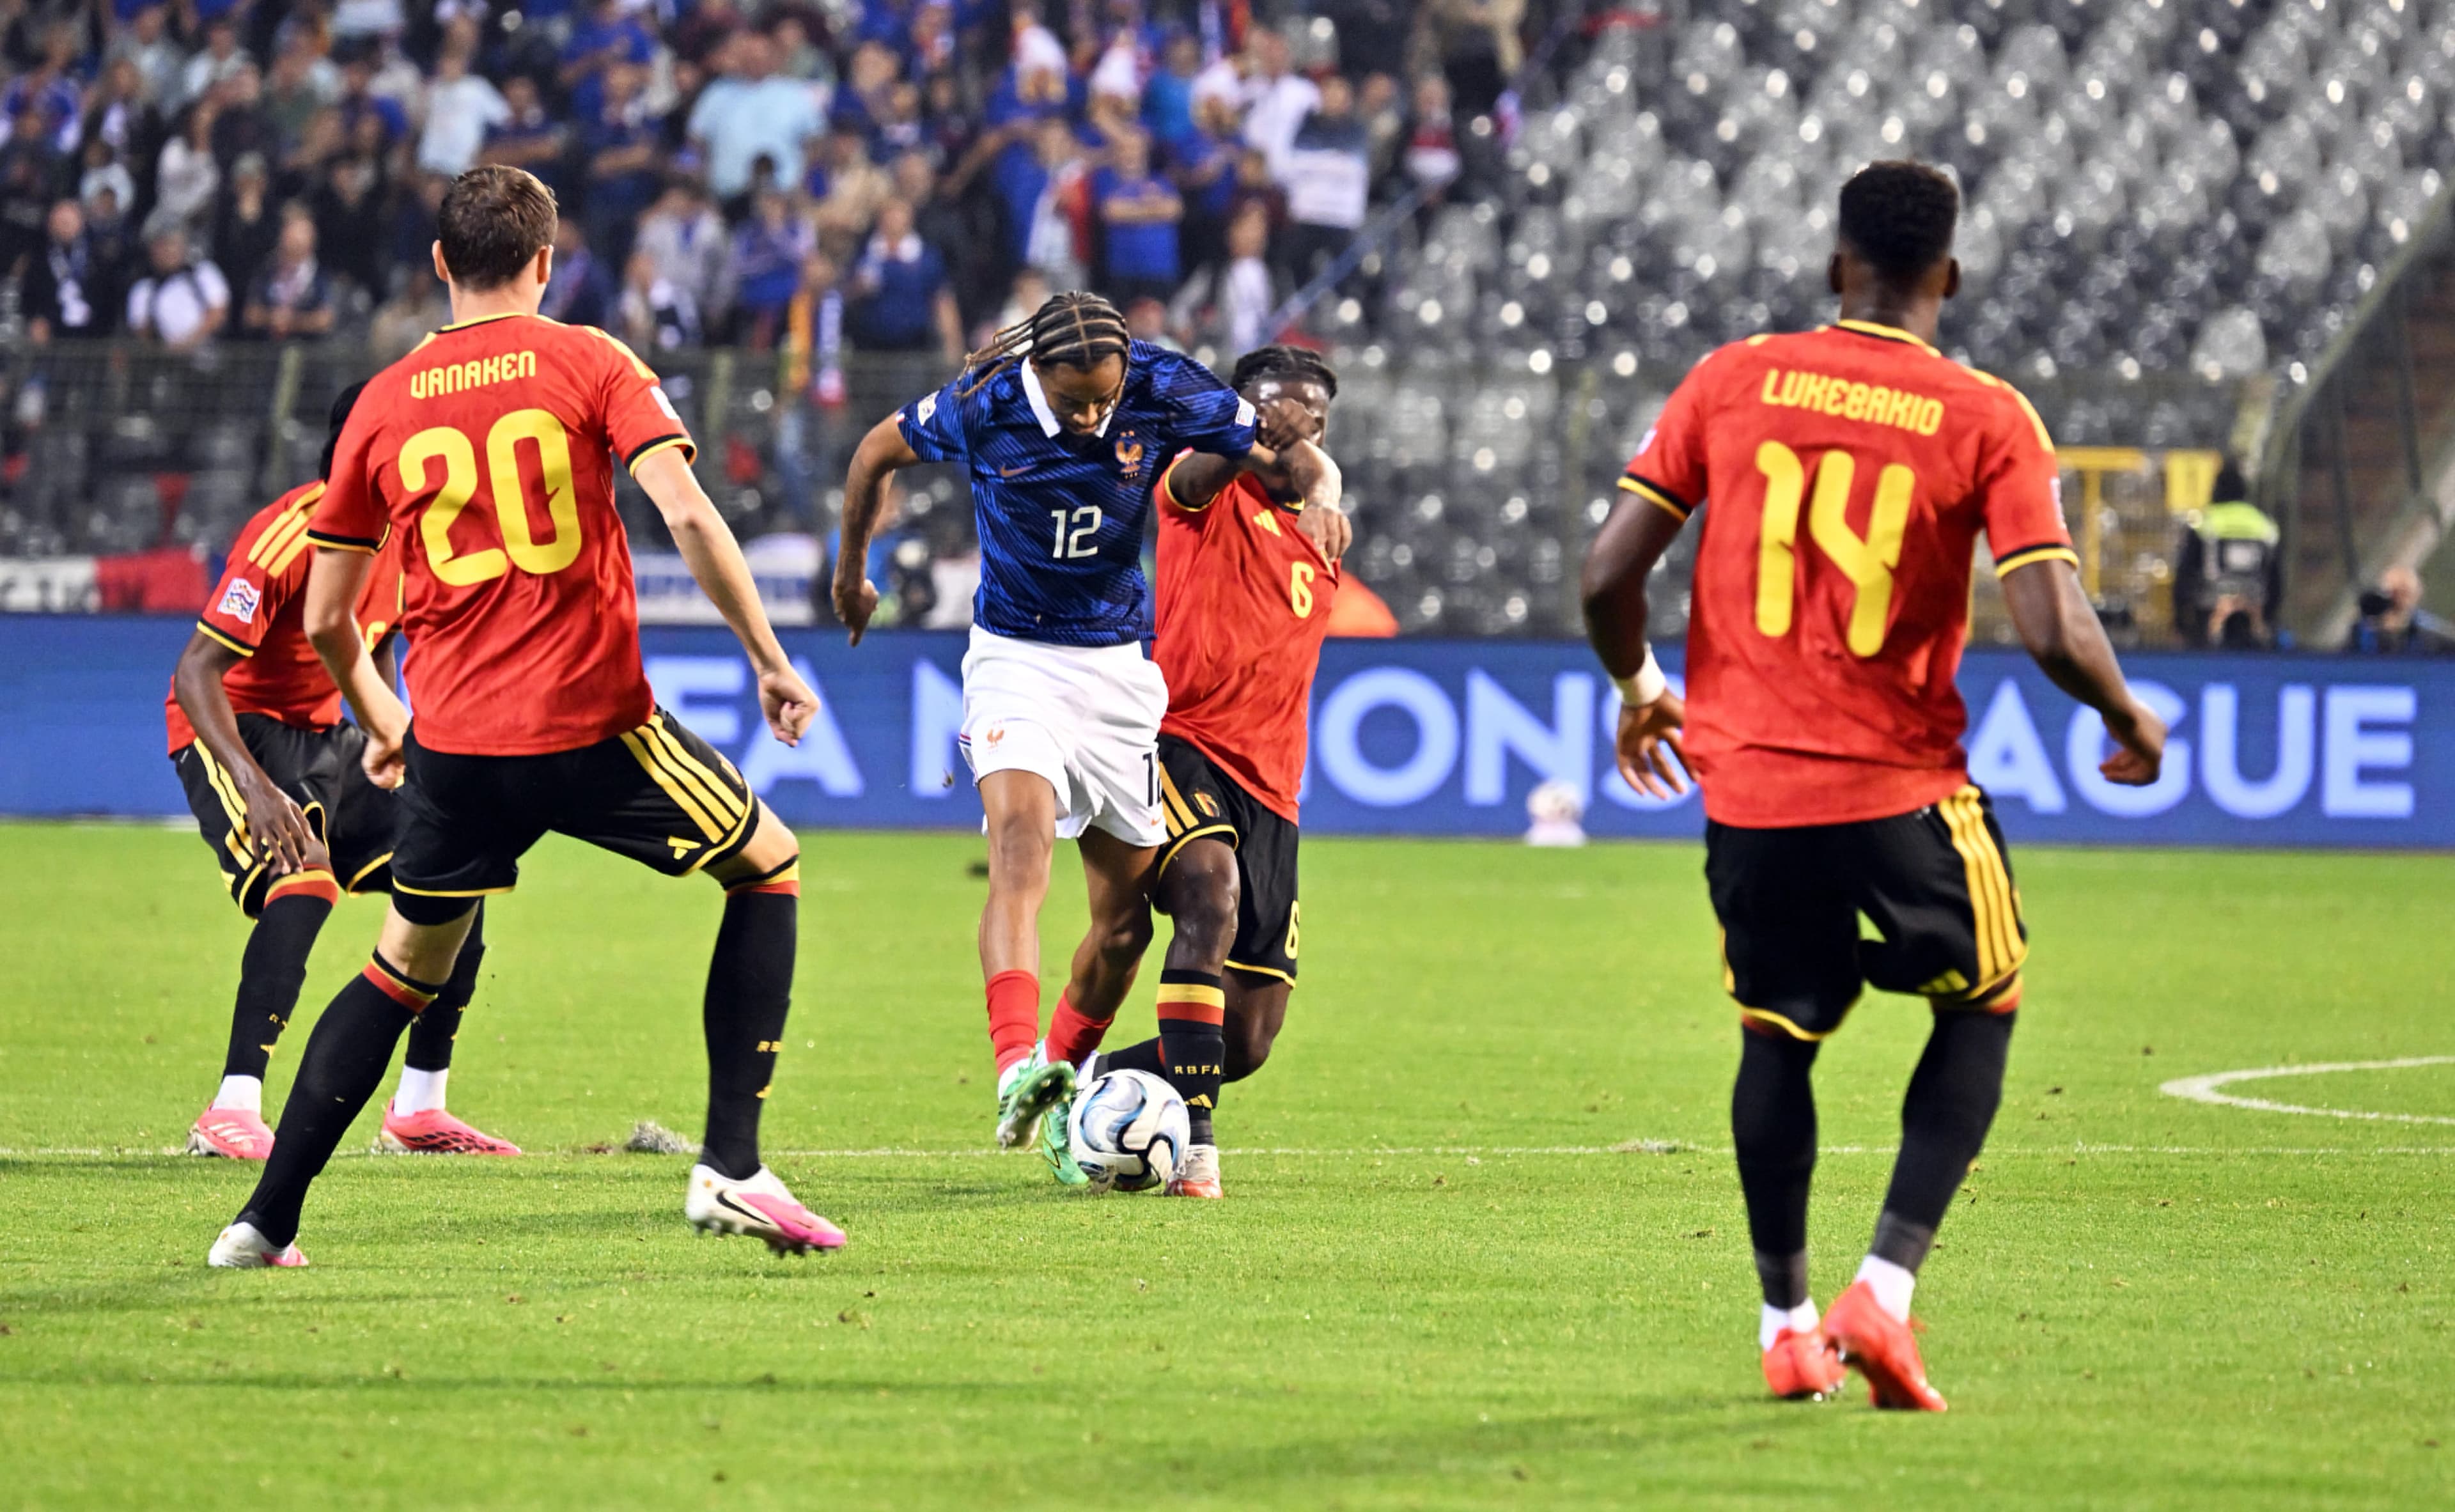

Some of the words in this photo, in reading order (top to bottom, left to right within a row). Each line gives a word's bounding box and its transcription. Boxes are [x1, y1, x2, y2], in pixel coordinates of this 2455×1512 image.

[410, 350, 536, 399] VANAKEN
[1761, 369, 1944, 435] LUKEBAKIO
[398, 409, 582, 586] 20
[1051, 506, 1102, 558] 12
[1756, 440, 1915, 657] 14
[1290, 561, 1316, 620] 6
[1967, 679, 2416, 818] AGUE
[1284, 900, 1299, 959] 6
[1174, 1064, 1220, 1075] RBFA
